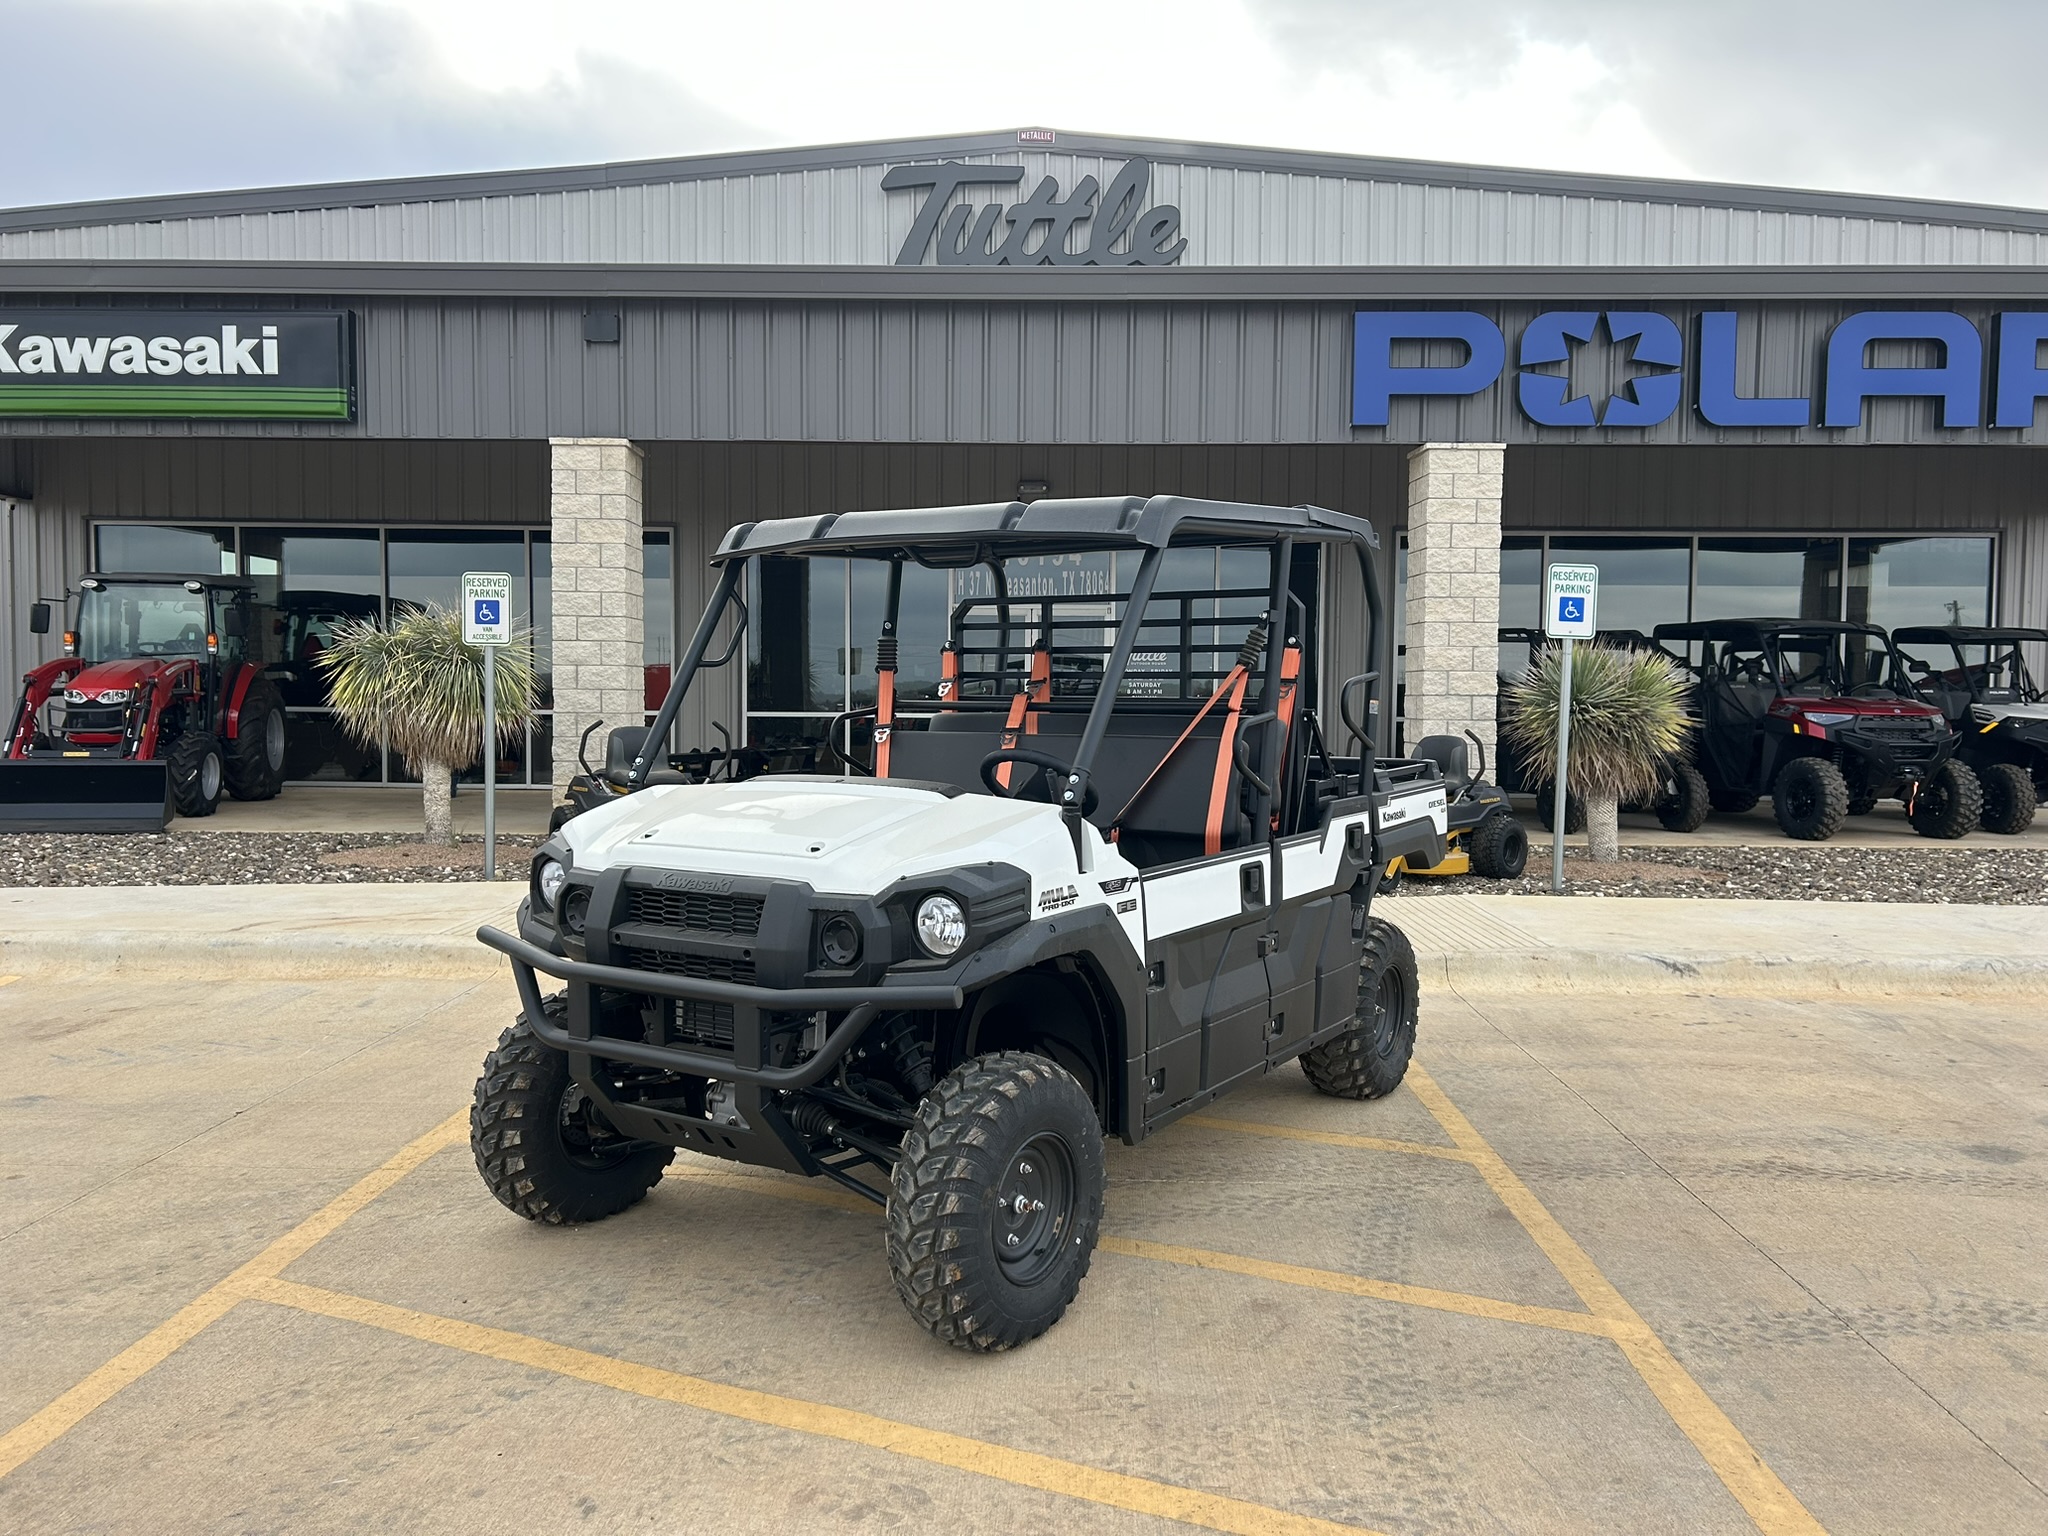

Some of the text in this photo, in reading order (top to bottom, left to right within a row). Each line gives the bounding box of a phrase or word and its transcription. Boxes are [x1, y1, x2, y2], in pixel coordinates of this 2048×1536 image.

[1021, 131, 1052, 140] METALLIC
[880, 157, 1188, 266] Tuttle
[466, 577, 508, 588] RESERVED
[1553, 571, 1595, 582] RESERVED
[969, 571, 980, 595] 37
[1007, 572, 1058, 596] easanton,
[1062, 570, 1076, 596] TX
[1080, 570, 1109, 596] 78064
[1554, 583, 1592, 595] PARKING
[469, 588, 505, 598] PARKING
[1382, 807, 1406, 823] Kawasaki
[656, 873, 734, 893] Kawasaki
[1118, 900, 1136, 913] FE
